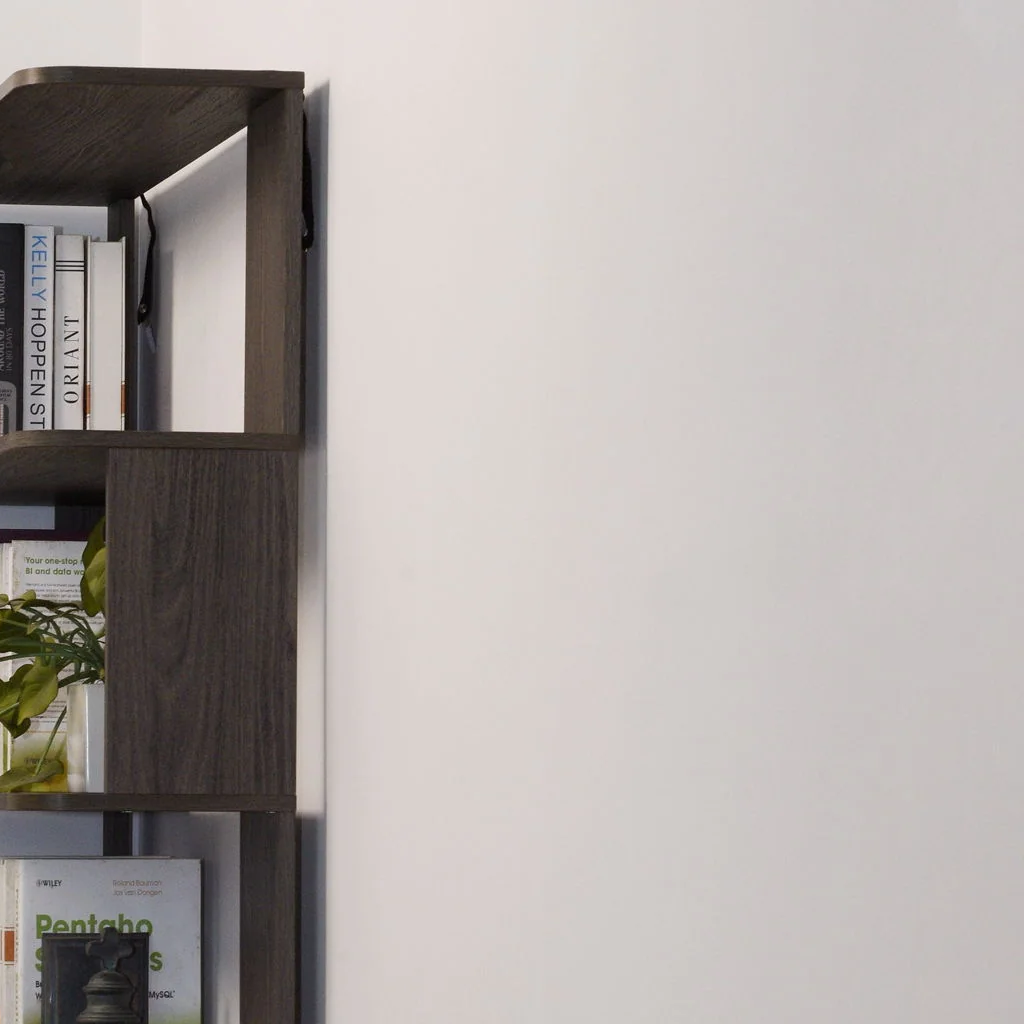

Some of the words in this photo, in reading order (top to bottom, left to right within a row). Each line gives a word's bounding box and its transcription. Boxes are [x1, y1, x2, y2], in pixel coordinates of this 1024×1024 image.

[31, 235, 48, 301] KELLY
[5, 327, 13, 349] DAYS
[30, 307, 47, 396] HOPPEN
[63, 315, 80, 404] ORIANT
[5, 362, 13, 372] IN
[25, 557, 44, 565] Your
[45, 557, 78, 566] one-stop
[43, 879, 63, 888] WILEY
